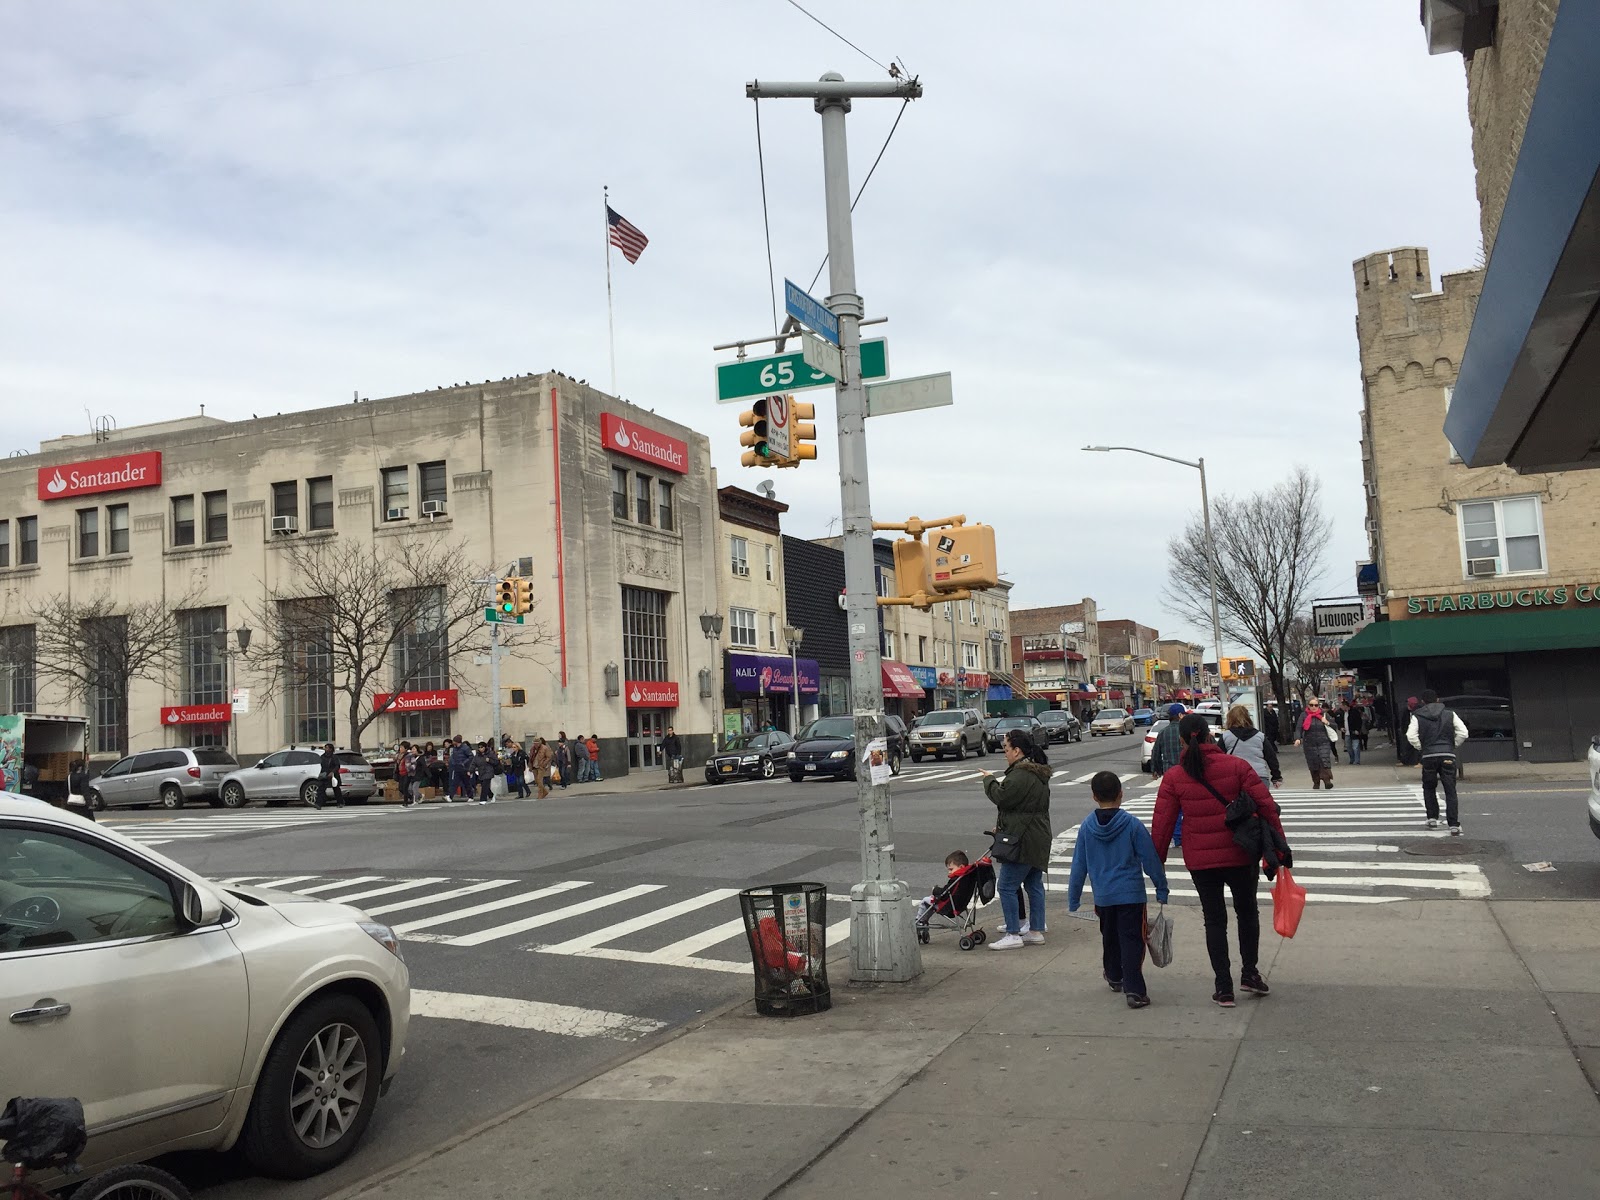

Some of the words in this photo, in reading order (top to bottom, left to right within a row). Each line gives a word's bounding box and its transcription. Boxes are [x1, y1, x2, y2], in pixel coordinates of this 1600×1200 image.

[810, 340, 824, 367] 18
[760, 361, 795, 387] 65
[920, 379, 937, 393] ST
[632, 431, 682, 466] Santander
[70, 462, 146, 489] Santander
[1407, 588, 1568, 614] STARBUCKS
[1319, 612, 1359, 628] LIQUORS
[1024, 639, 1059, 651] PIZZA
[735, 668, 756, 677] NAILS
[773, 669, 796, 687] Beauty
[398, 694, 446, 708] Santander
[642, 688, 677, 702] Santander
[181, 708, 224, 721] Santander
